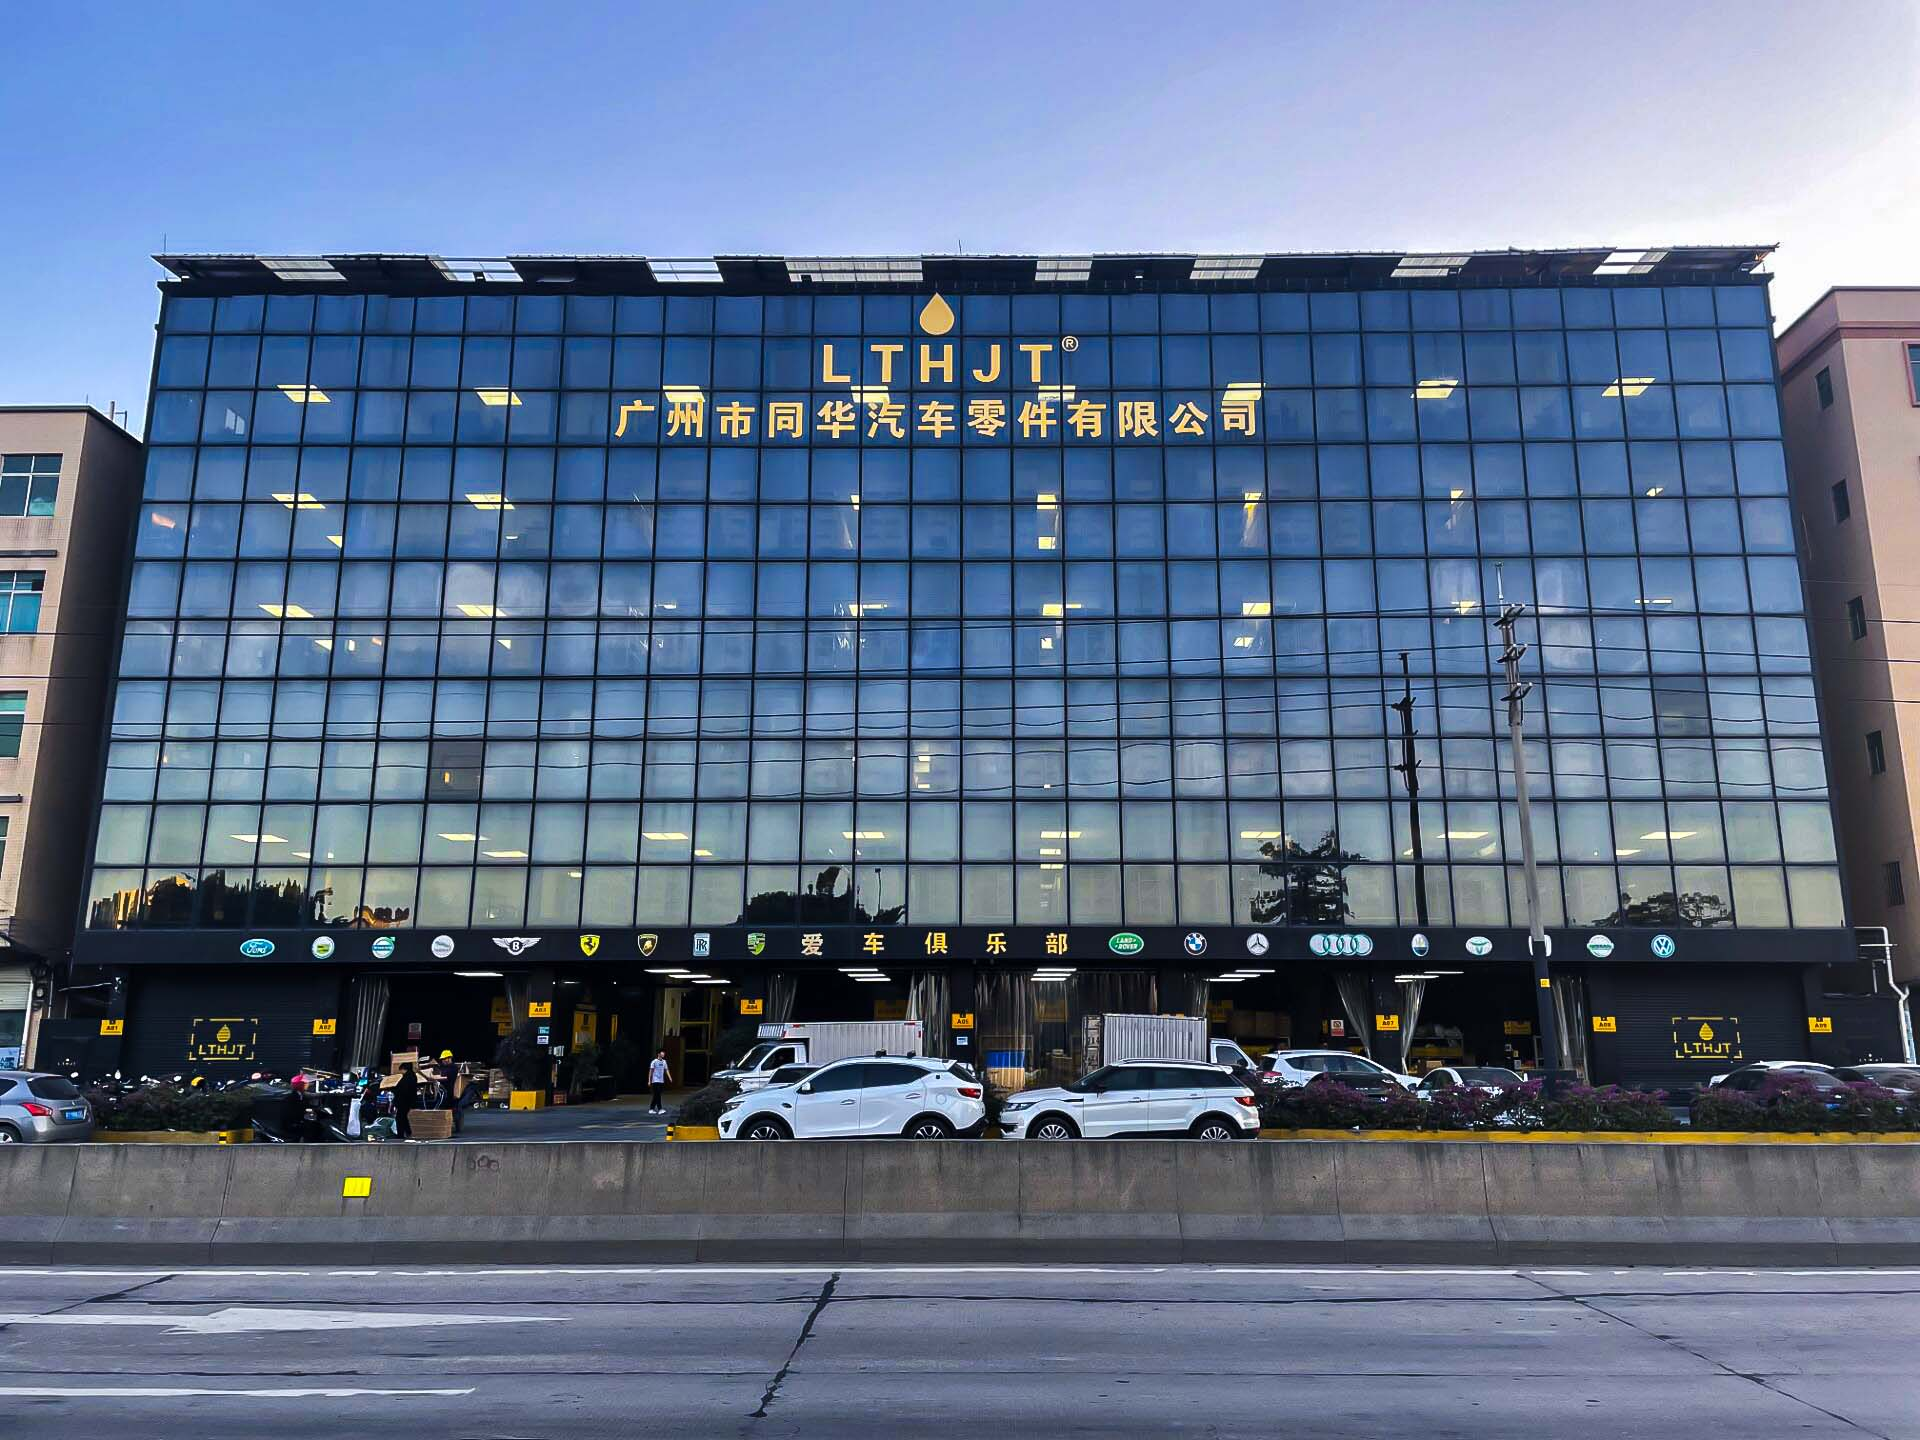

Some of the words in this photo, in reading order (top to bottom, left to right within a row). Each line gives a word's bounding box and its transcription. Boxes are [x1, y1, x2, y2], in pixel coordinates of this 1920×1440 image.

[614, 399, 1257, 439] 广州市同华汽车零件有限公司
[800, 931, 1068, 956] 爱车俱乐部
[198, 1044, 246, 1055] LTHJT
[1683, 1042, 1732, 1053] LTHJT
